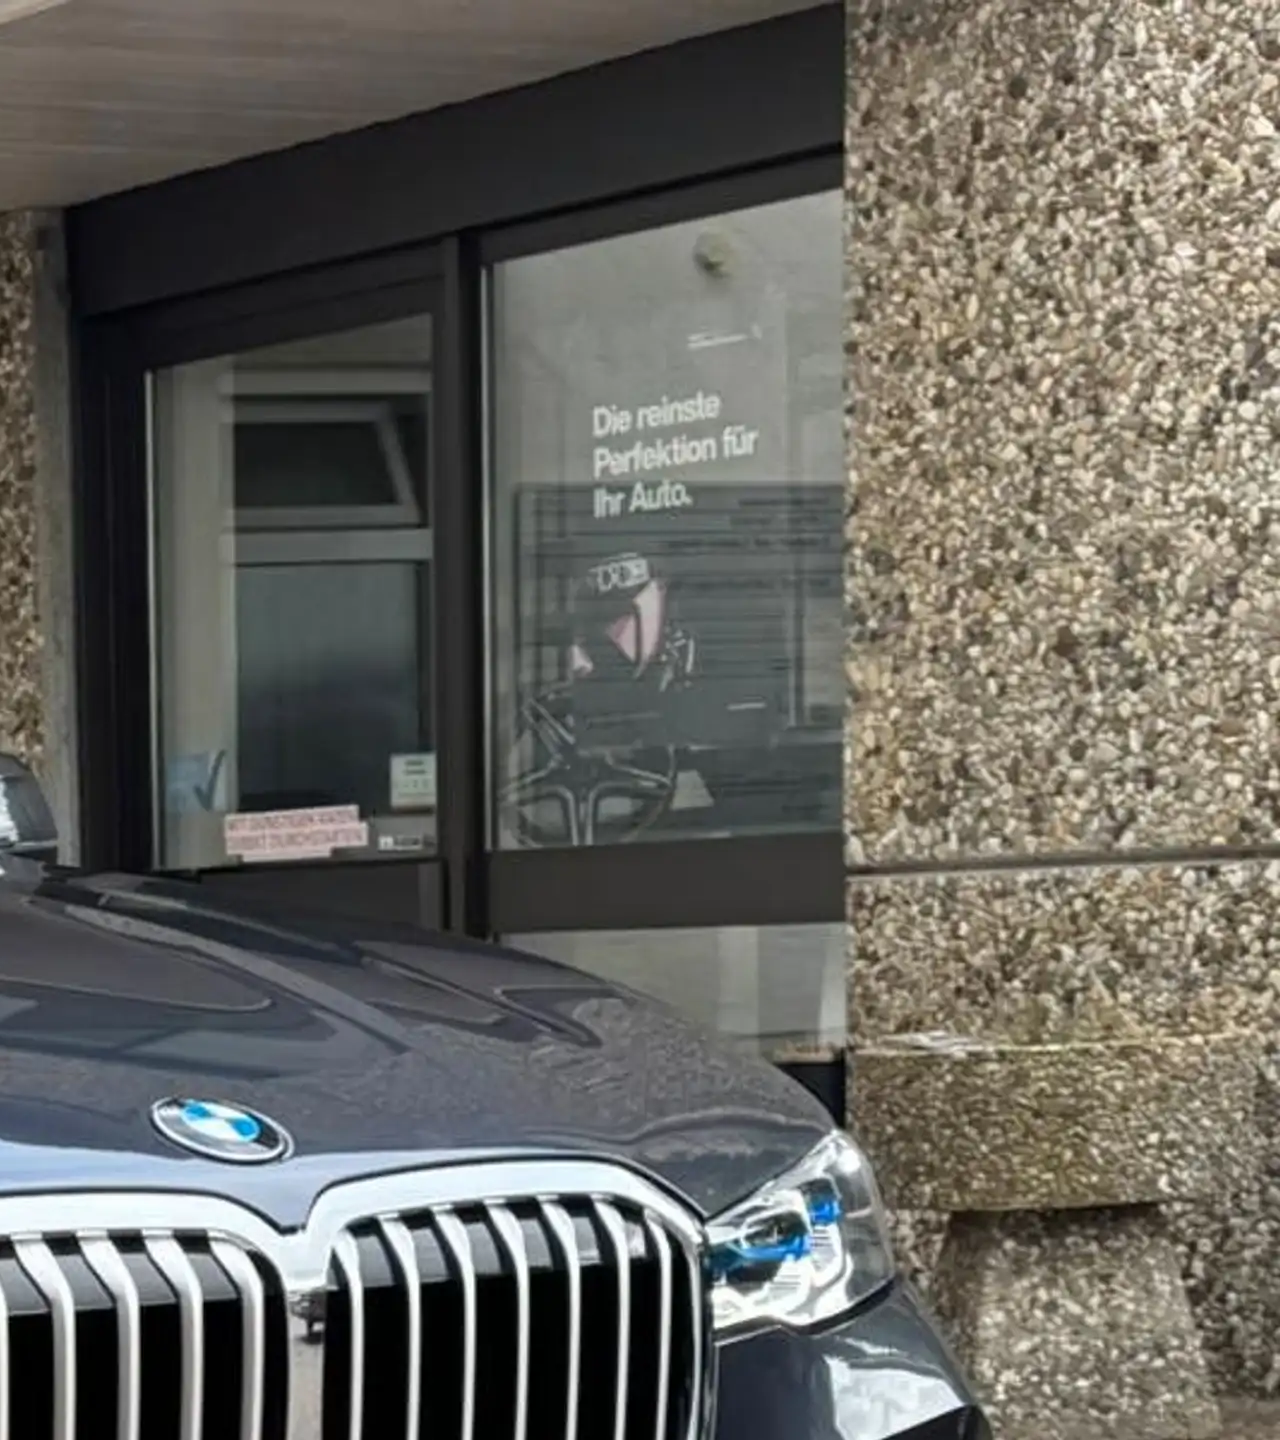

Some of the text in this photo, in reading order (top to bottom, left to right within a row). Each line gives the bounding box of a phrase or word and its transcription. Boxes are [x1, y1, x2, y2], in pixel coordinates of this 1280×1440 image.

[593, 391, 721, 438] Die reinste
[594, 424, 759, 479] Perfektion für
[594, 481, 692, 519] Ihr Auto.
